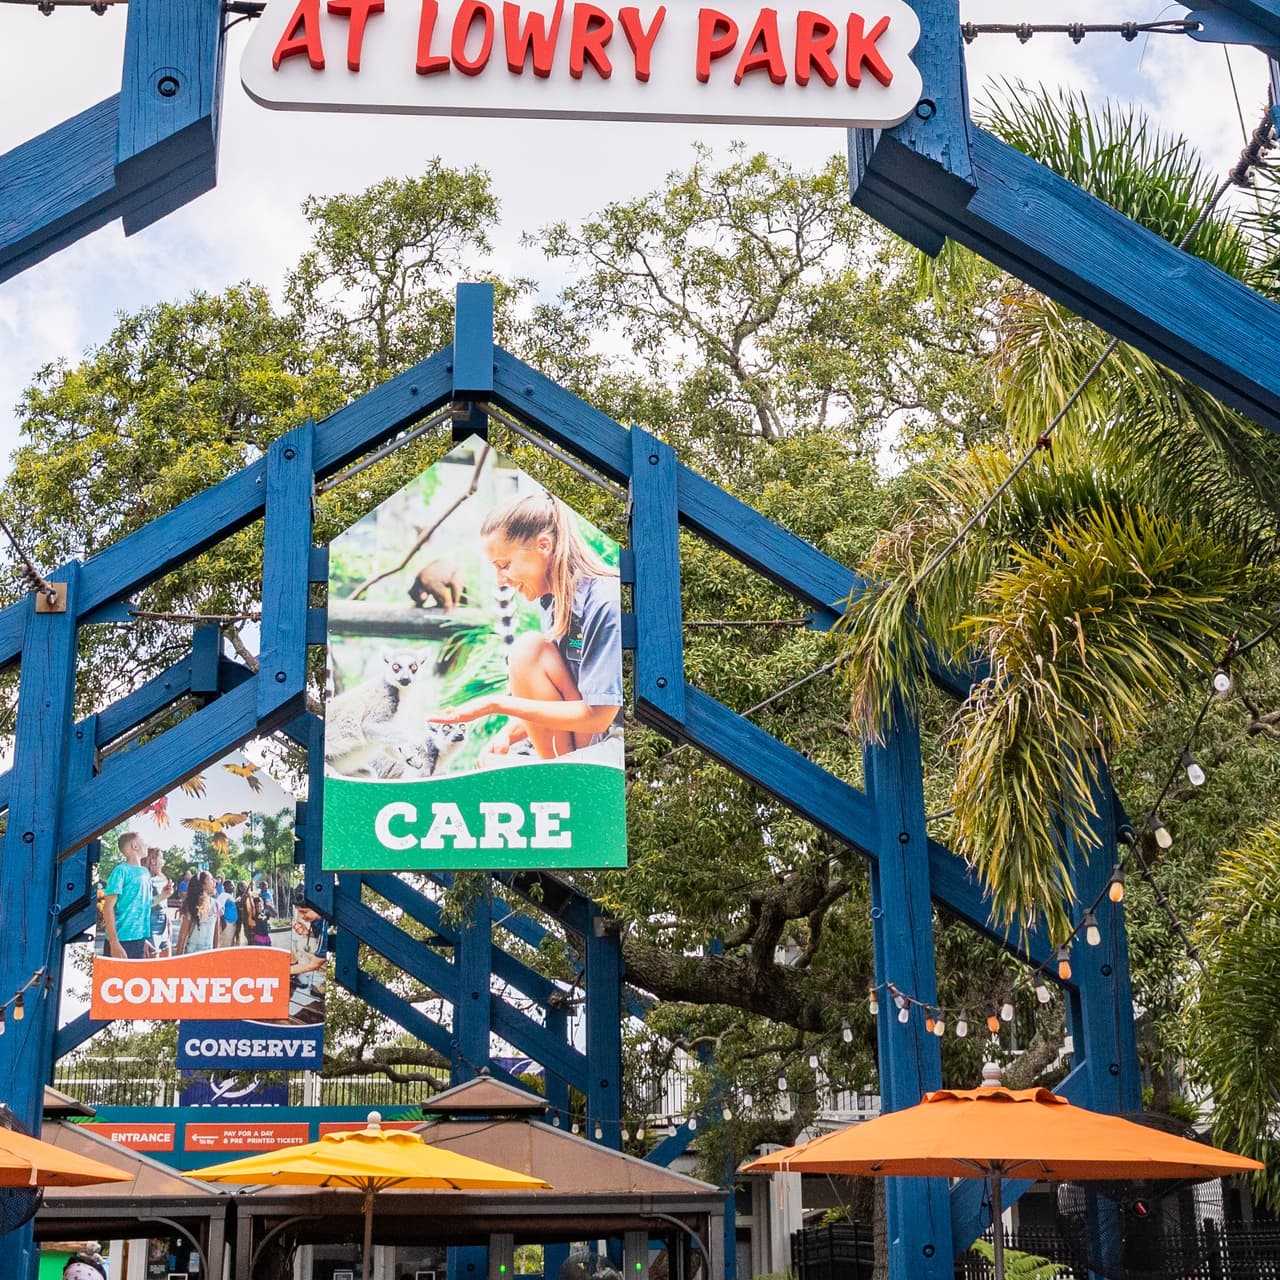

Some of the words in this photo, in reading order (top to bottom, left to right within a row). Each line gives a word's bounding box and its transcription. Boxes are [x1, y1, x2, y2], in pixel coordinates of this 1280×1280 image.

[695, 7, 894, 89] PARK
[374, 801, 573, 850] CARE
[100, 976, 280, 1005] CONNECT
[184, 1038, 317, 1058] CONSERVE
[111, 1132, 172, 1143] ENTRANCE
